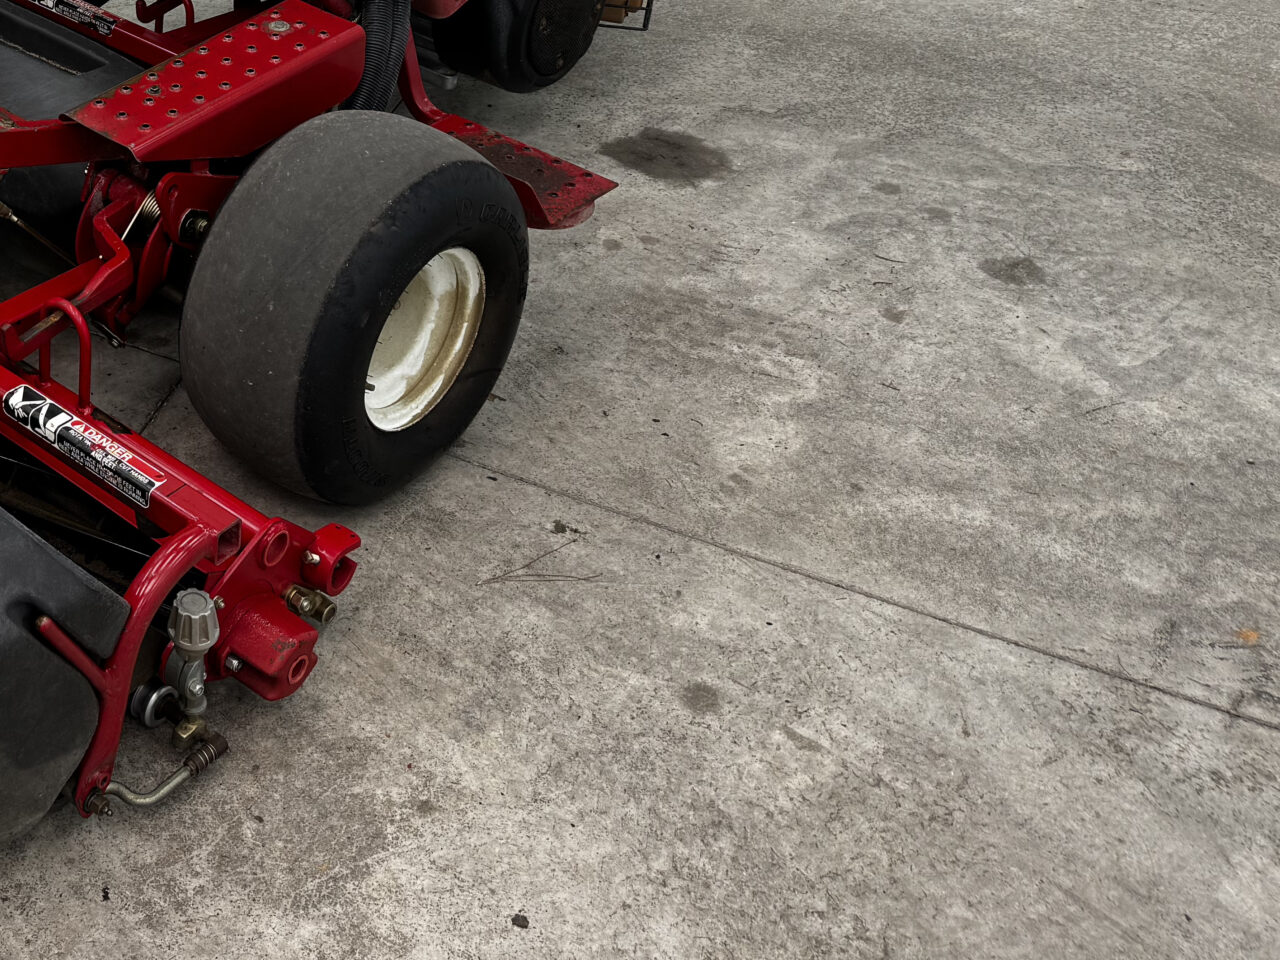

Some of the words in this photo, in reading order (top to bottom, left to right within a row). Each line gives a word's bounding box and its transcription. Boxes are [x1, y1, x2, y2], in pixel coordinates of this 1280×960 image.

[84, 430, 132, 462] DANGER
[90, 450, 102, 462] AND
[119, 463, 131, 471] CUT
